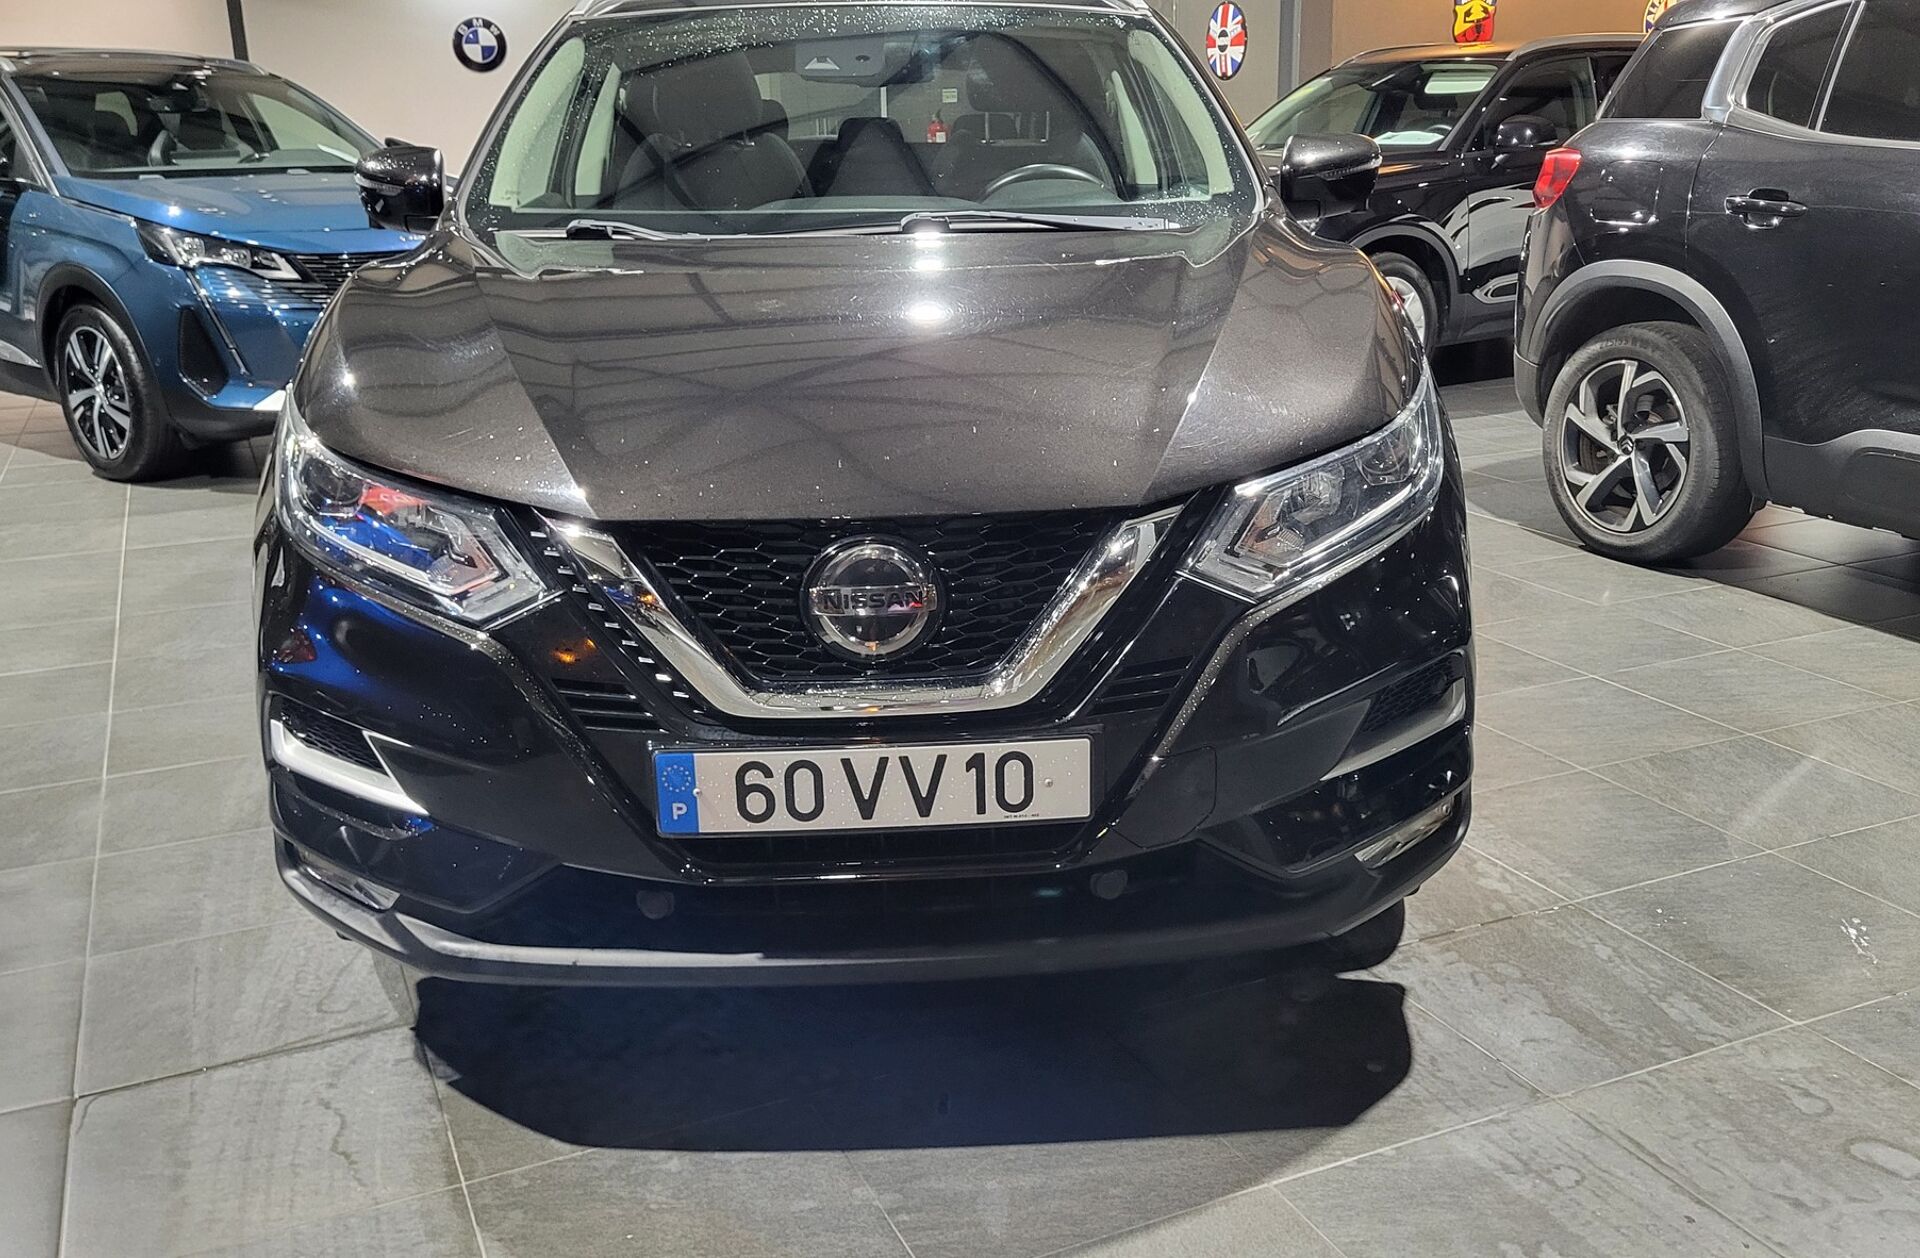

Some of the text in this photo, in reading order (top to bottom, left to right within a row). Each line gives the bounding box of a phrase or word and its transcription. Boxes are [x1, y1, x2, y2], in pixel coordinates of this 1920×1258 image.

[458, 18, 501, 36] BMW
[821, 590, 924, 610] NISSAN
[672, 803, 688, 820] P
[735, 759, 824, 823] 60
[965, 751, 1034, 815] 10
